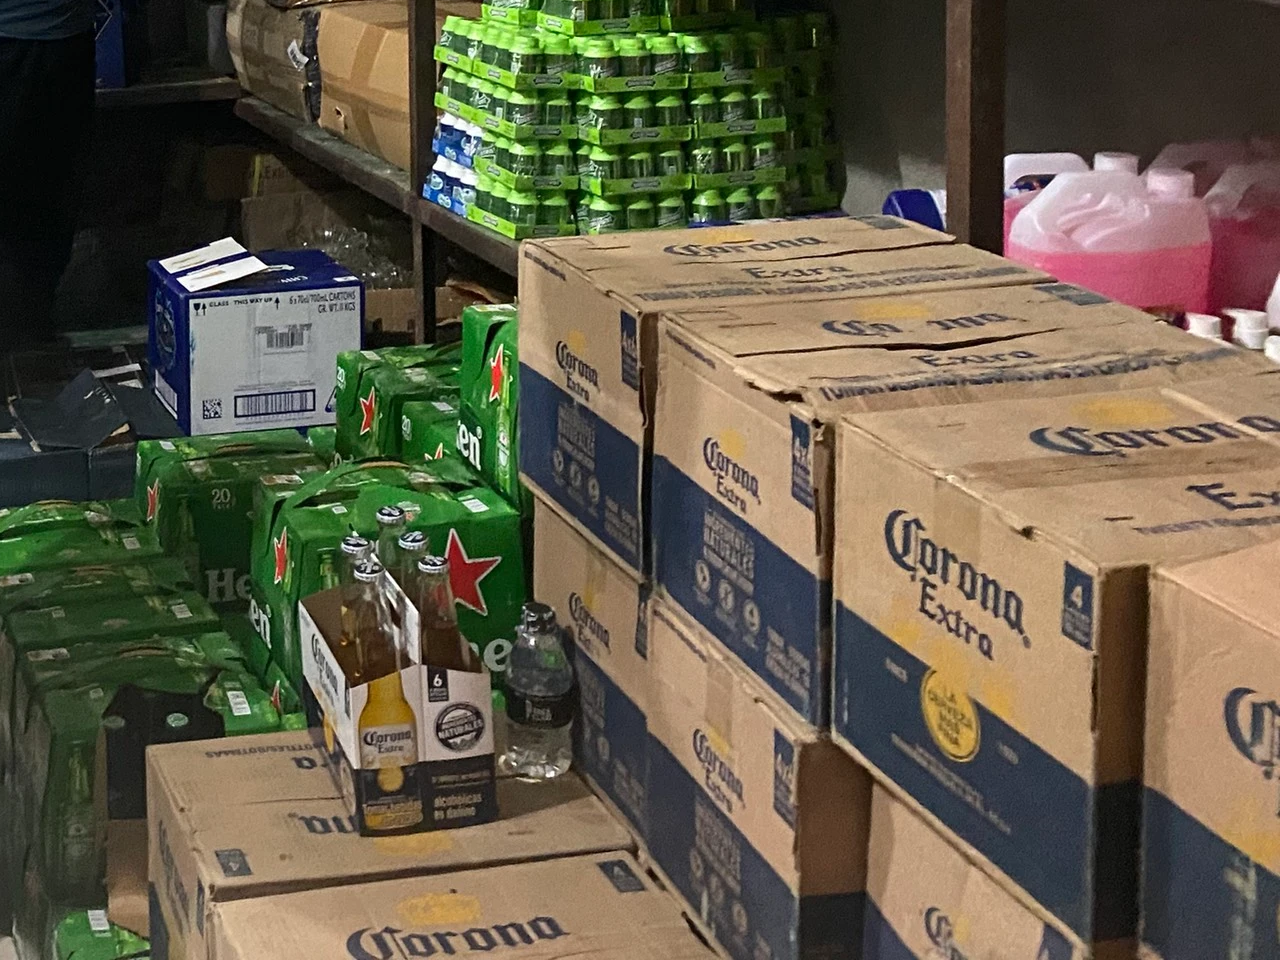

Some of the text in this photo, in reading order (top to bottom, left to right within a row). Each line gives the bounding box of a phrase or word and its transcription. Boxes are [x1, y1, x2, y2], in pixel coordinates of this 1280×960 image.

[663, 233, 826, 258] Corona
[746, 263, 849, 281] Extra
[556, 340, 599, 392] Corona
[910, 350, 1042, 371] Extra
[567, 371, 590, 401] Extra
[703, 436, 761, 505] Corona
[211, 488, 231, 503] 20
[716, 473, 747, 514] Extra
[885, 509, 1025, 637] Corona
[1070, 585, 1084, 609] 4
[570, 592, 611, 654] Corona
[919, 576, 995, 661] Extra
[433, 674, 443, 687] 6
[363, 730, 412, 746] Corona
[438, 719, 484, 740] NATURALES
[345, 915, 571, 960] Corona
